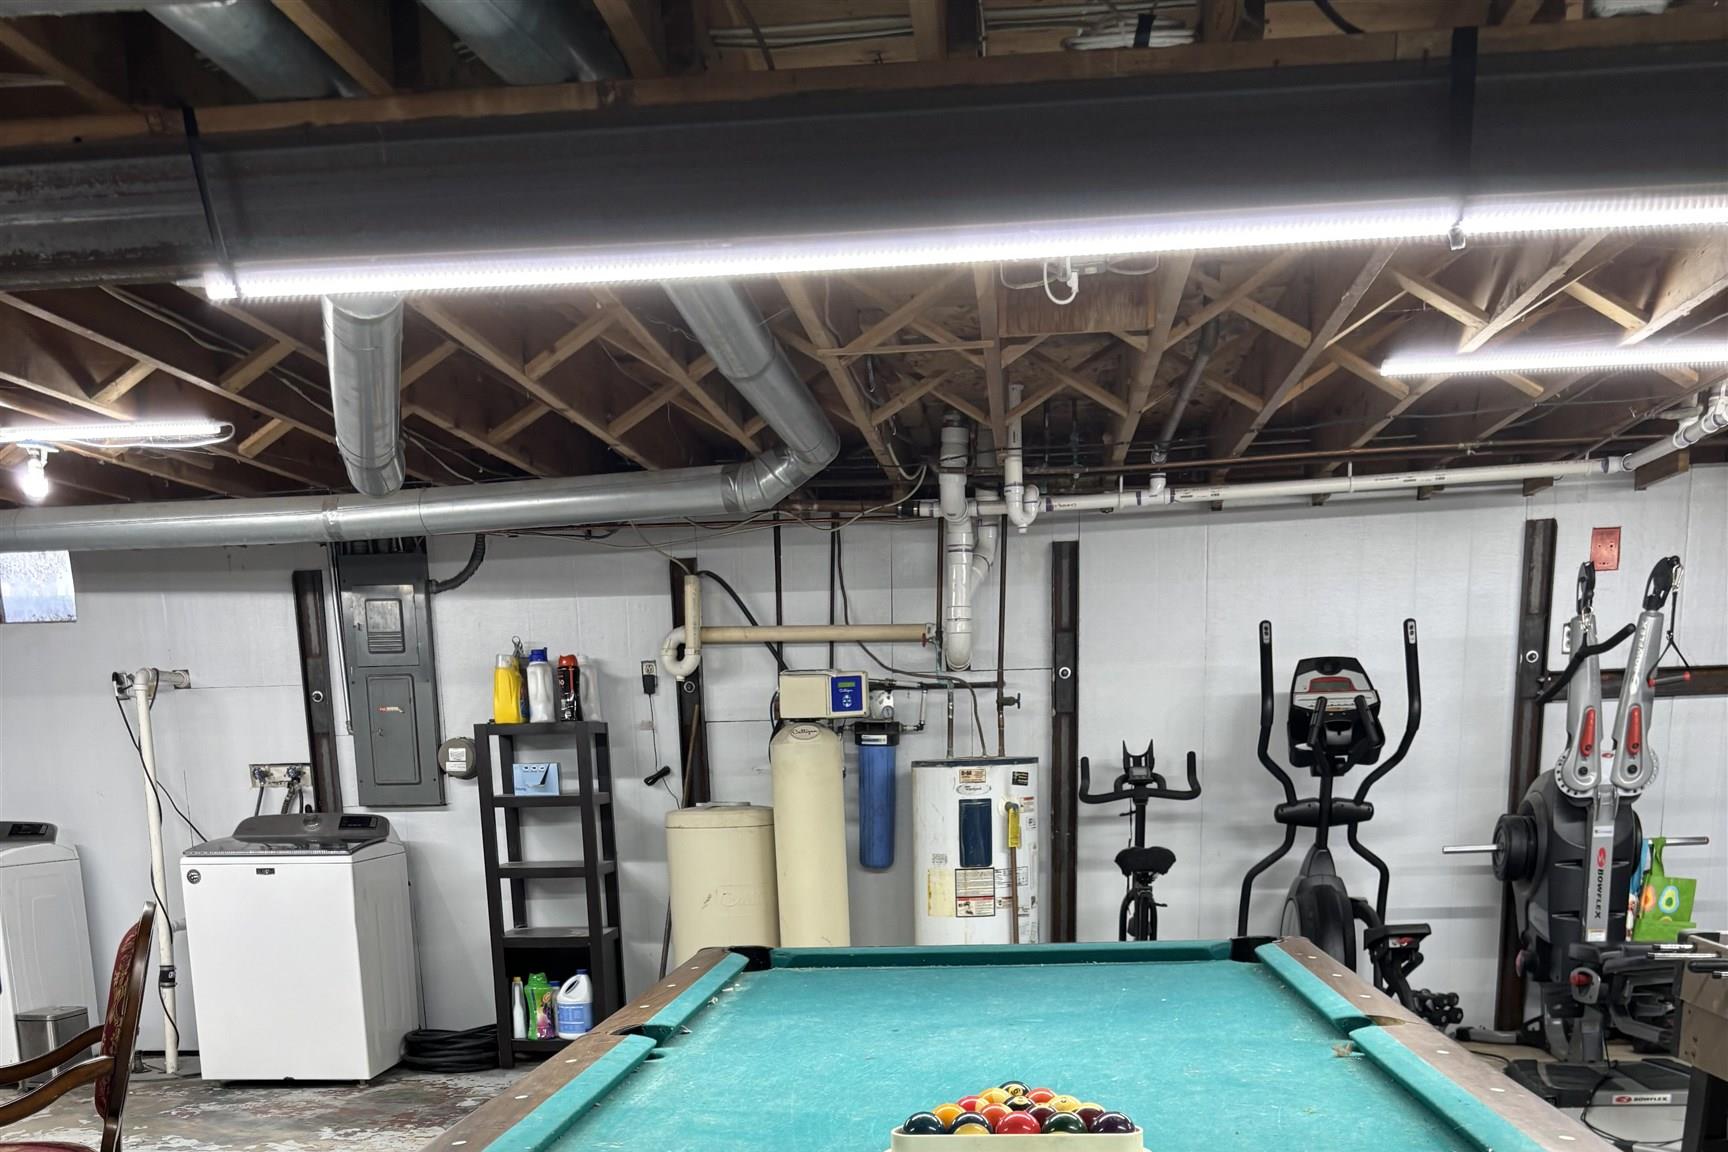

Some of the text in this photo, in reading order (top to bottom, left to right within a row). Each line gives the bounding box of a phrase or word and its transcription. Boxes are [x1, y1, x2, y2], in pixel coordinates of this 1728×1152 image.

[1632, 618, 1649, 674] BOWFLEX
[791, 728, 818, 736] Culligan
[1594, 868, 1605, 919] BOWFLEX
